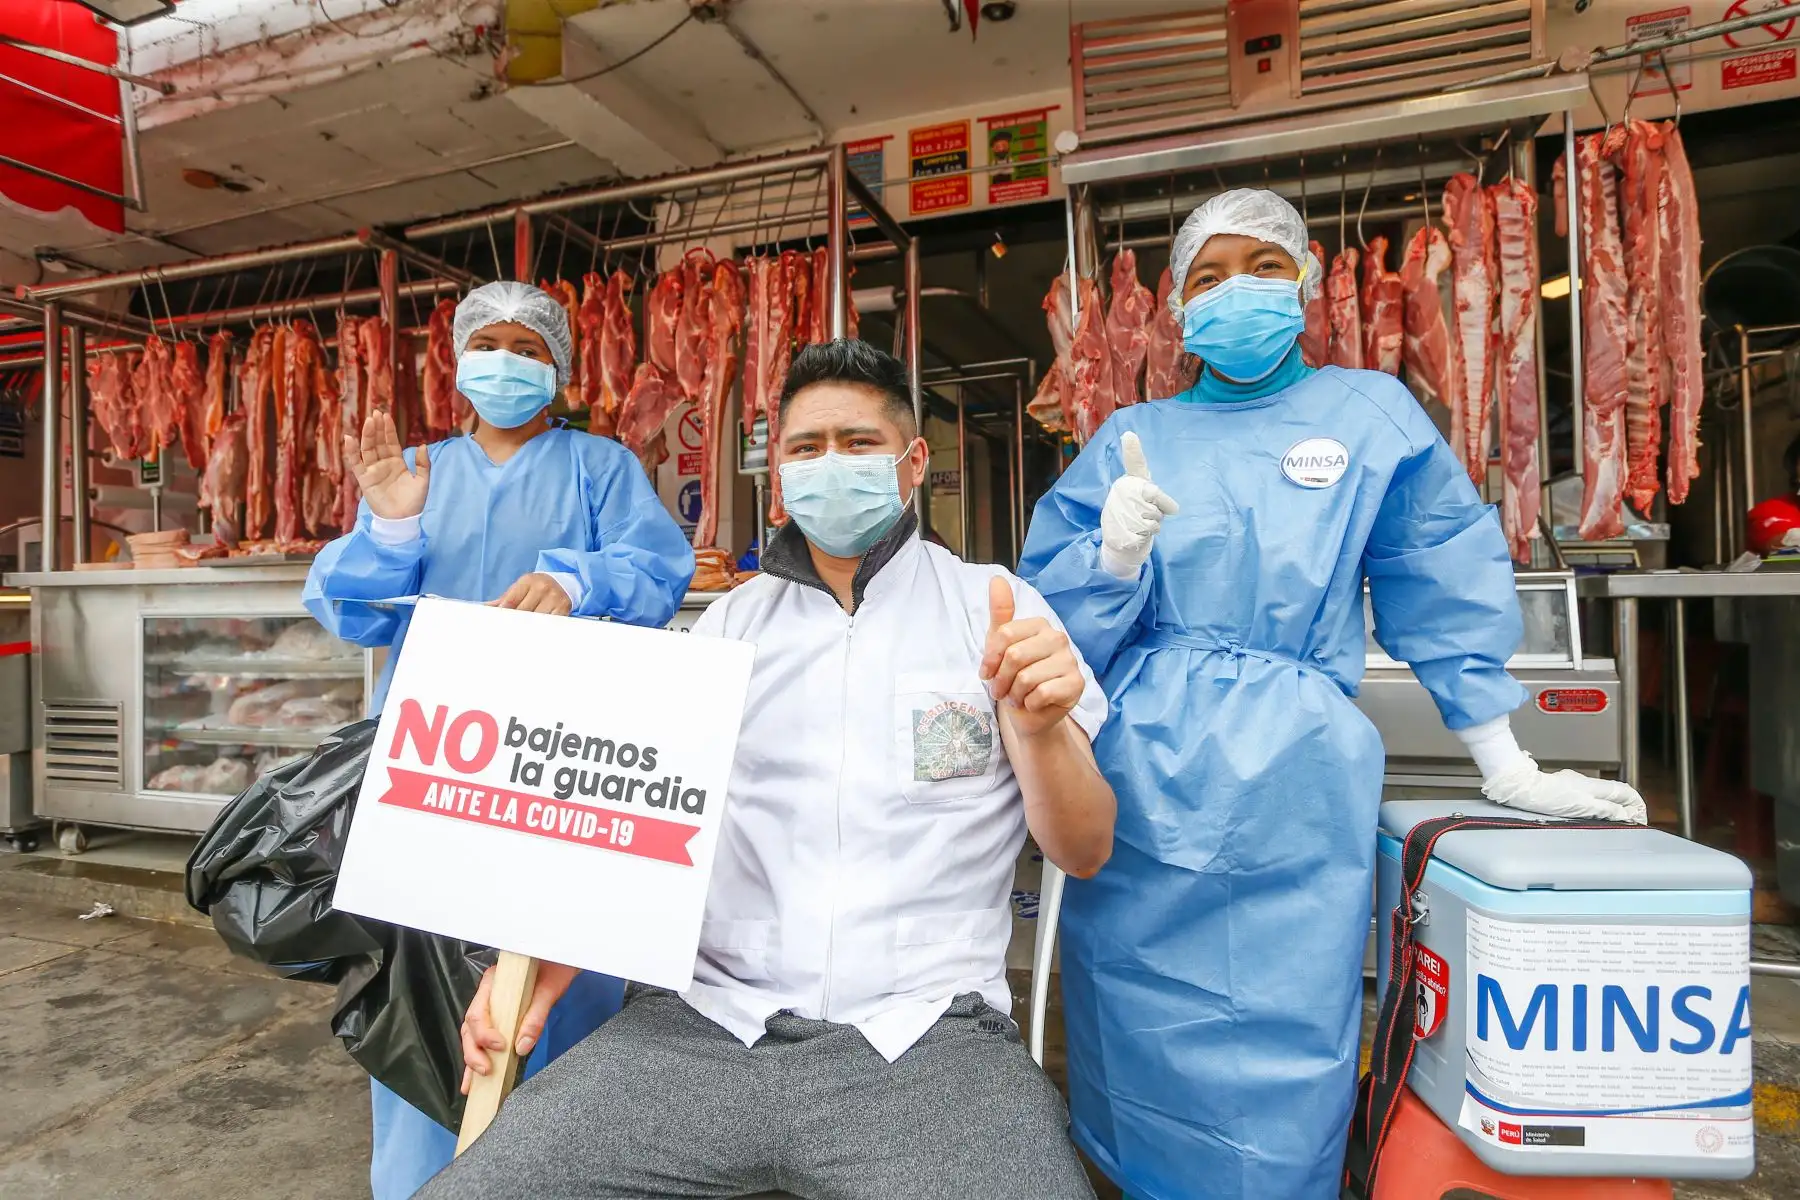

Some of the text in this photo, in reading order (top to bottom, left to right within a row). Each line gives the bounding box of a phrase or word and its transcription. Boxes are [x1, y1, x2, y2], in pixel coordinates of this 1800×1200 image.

[1724, 50, 1794, 70] PROHIBIDO
[1736, 61, 1782, 76] FUMAR
[1287, 454, 1345, 468] MINSA
[932, 472, 959, 484] AFOR
[388, 698, 658, 774] NO bajemos
[510, 752, 707, 815] la guardia
[422, 782, 635, 847] ANTE LA COVID-19
[1477, 973, 1751, 1055] MINSA
[1501, 1128, 1520, 1138] PERÚ
